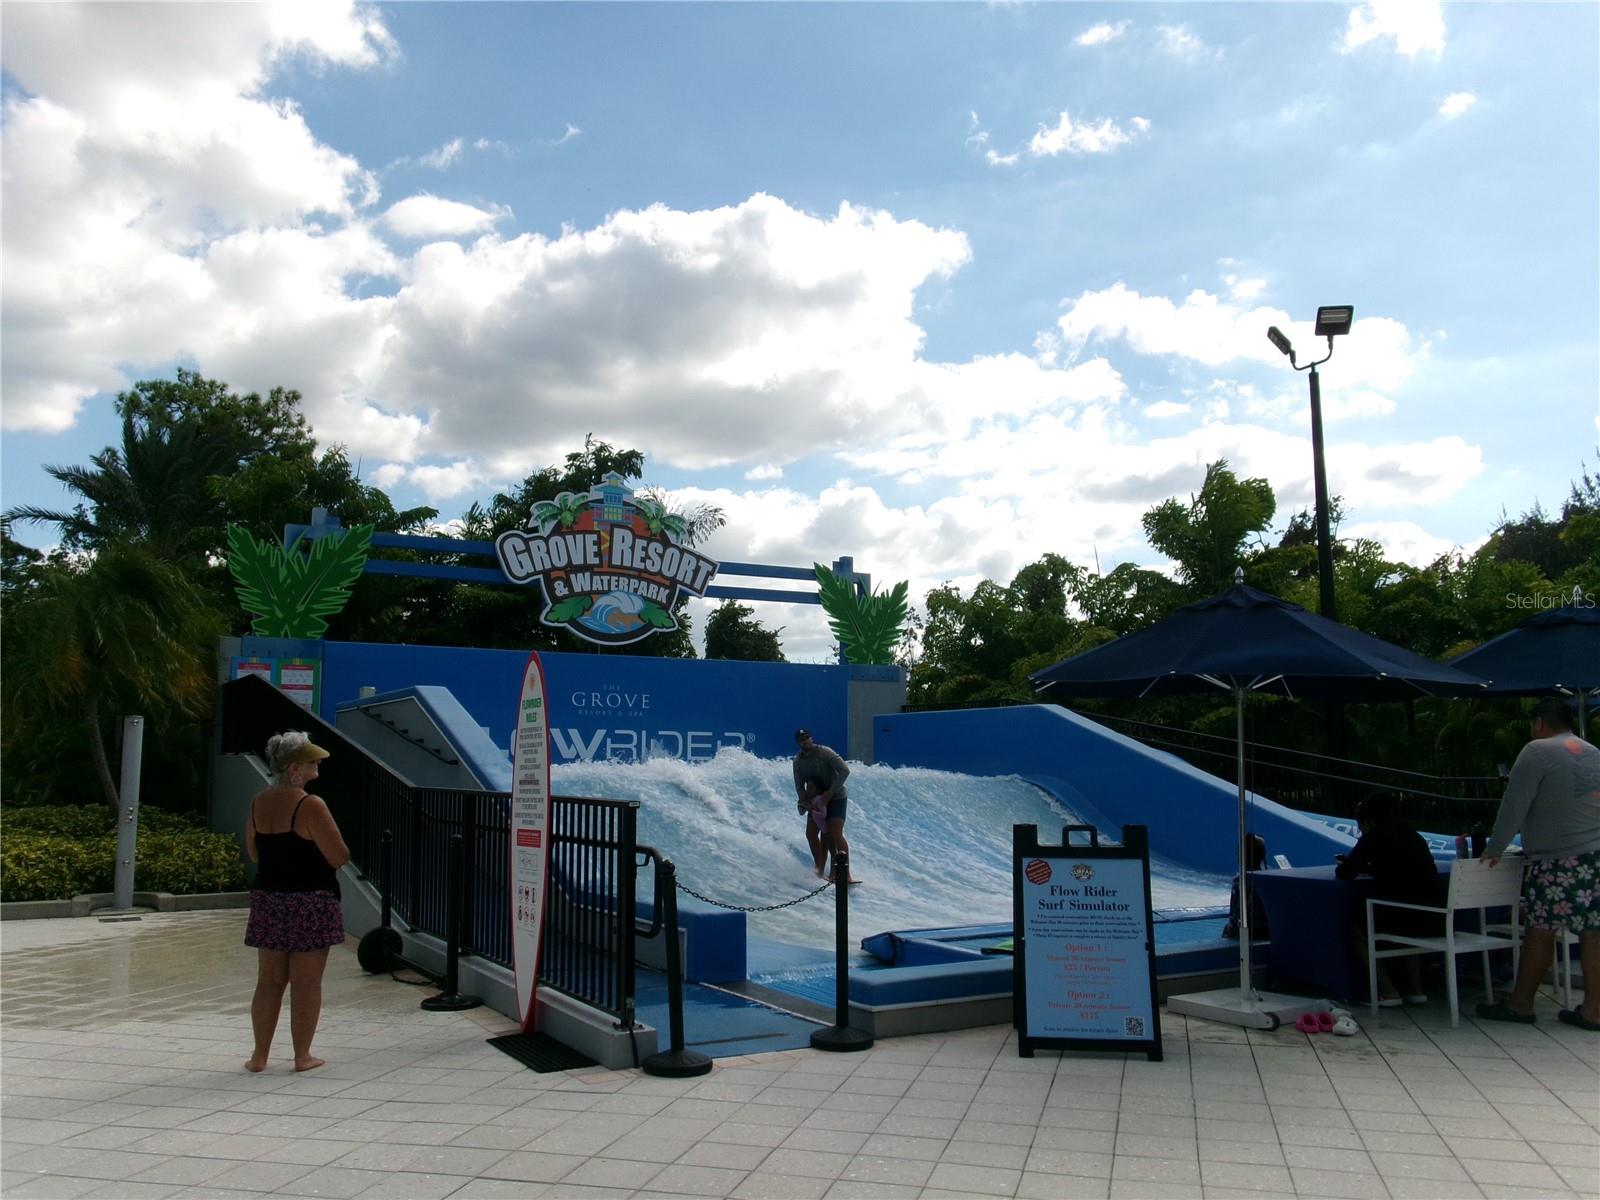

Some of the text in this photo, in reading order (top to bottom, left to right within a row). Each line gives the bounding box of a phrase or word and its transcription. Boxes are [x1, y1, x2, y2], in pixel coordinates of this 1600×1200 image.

[502, 527, 714, 591] GROVE RESORT
[554, 571, 670, 603] & WATERPARK
[571, 691, 651, 709] GROVE
[1050, 885, 1118, 897] Flow Rider
[1038, 899, 1130, 912] Surf Simulator
